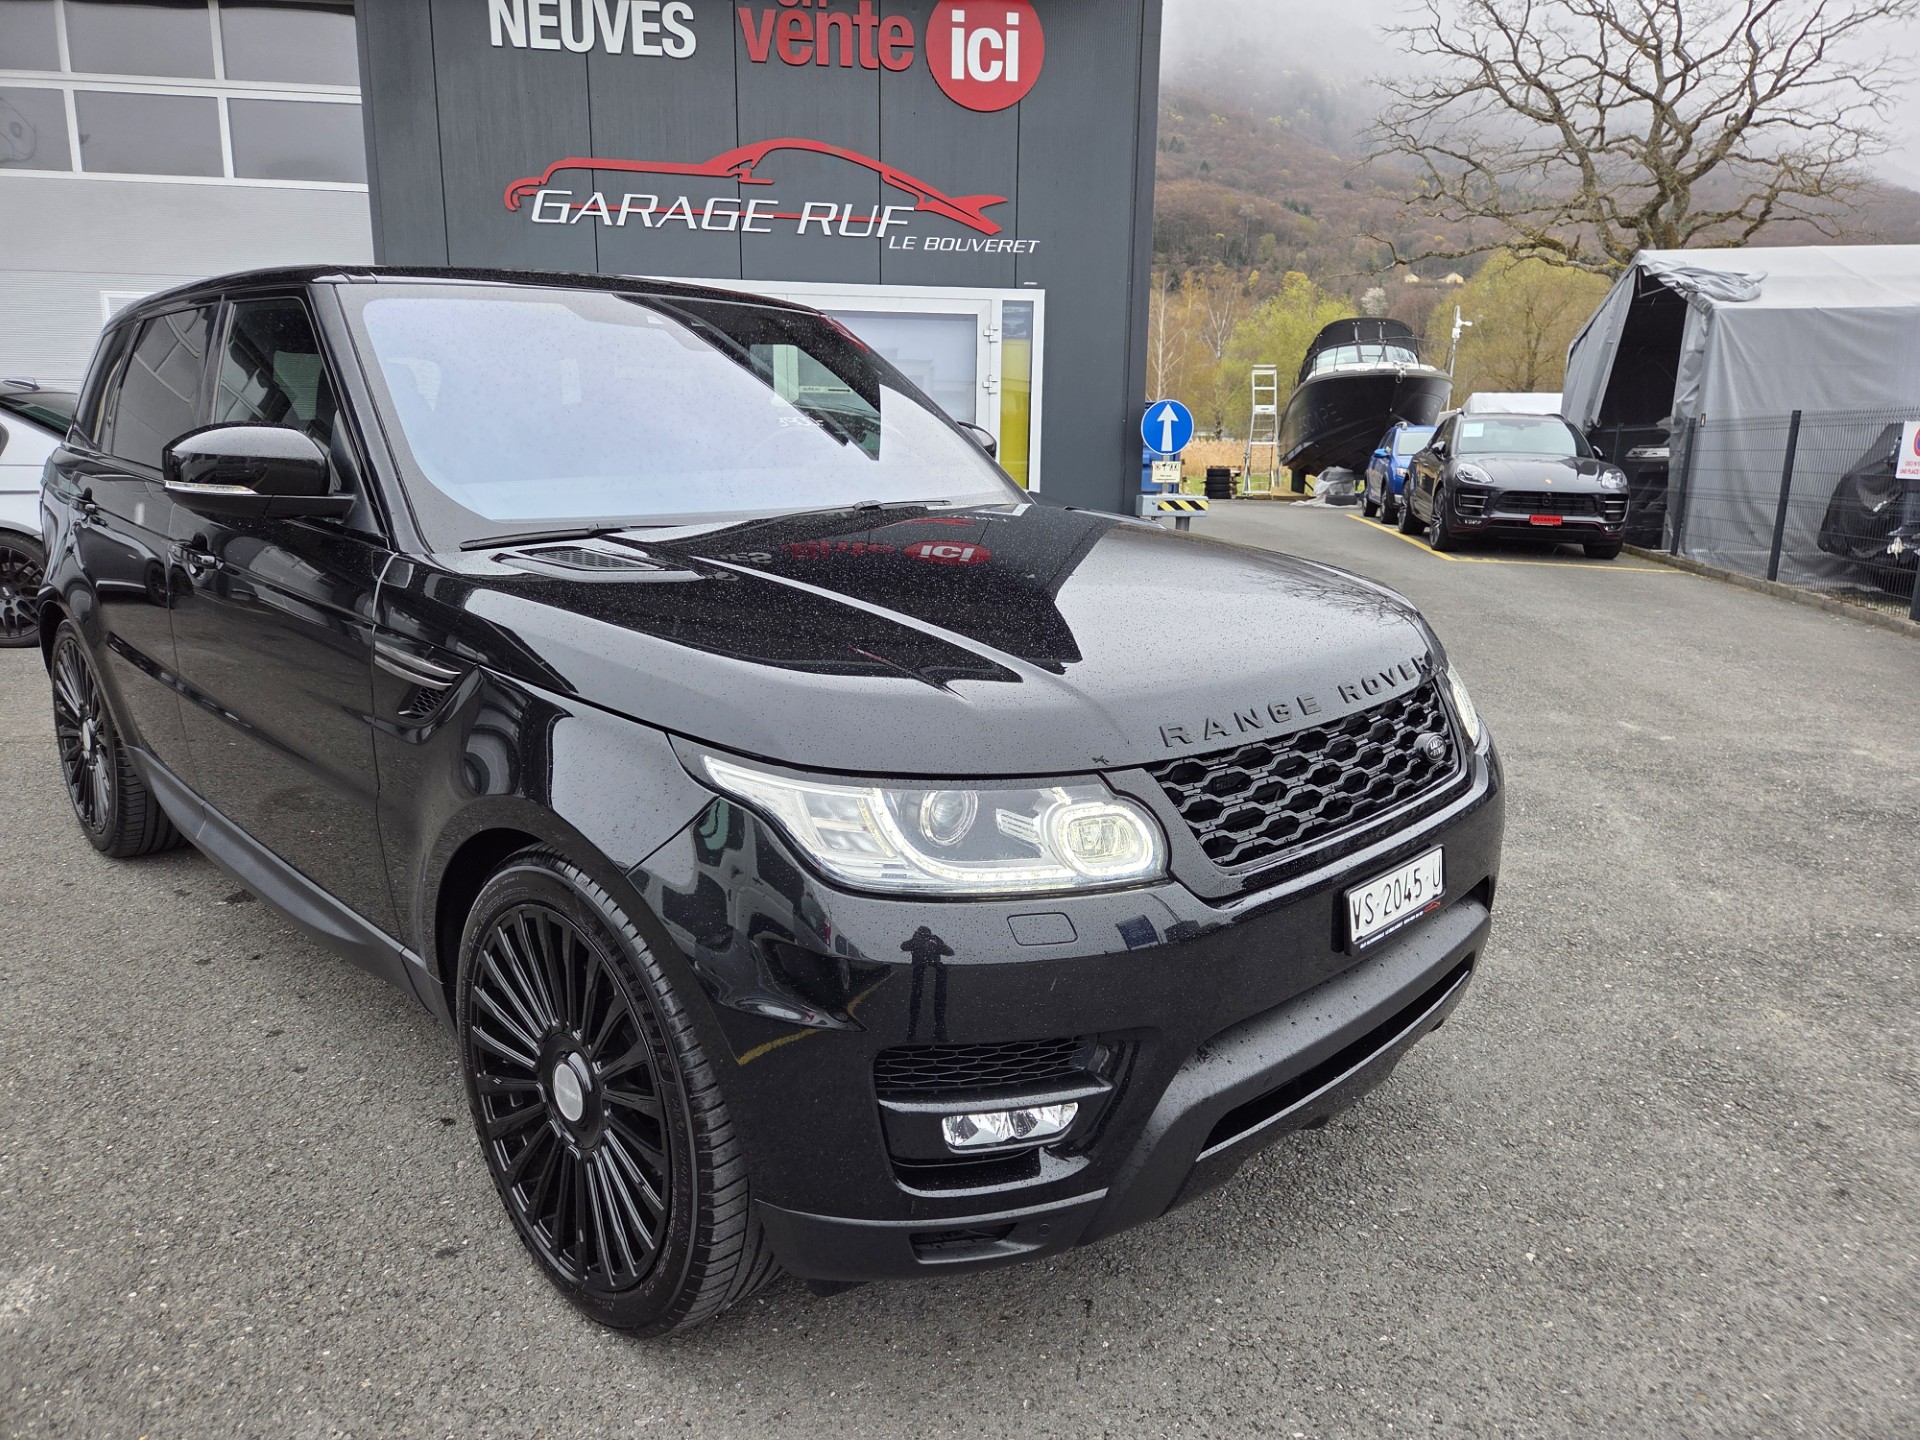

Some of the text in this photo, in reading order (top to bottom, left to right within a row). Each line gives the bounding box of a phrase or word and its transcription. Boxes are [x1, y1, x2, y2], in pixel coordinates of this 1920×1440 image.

[489, 0, 697, 59] NEUVES
[738, 0, 1020, 83] vente ici
[530, 189, 916, 238] GARAGE RUF
[888, 235, 1041, 255] LE BOUVERET
[1158, 656, 1431, 748] RANGE ROVER
